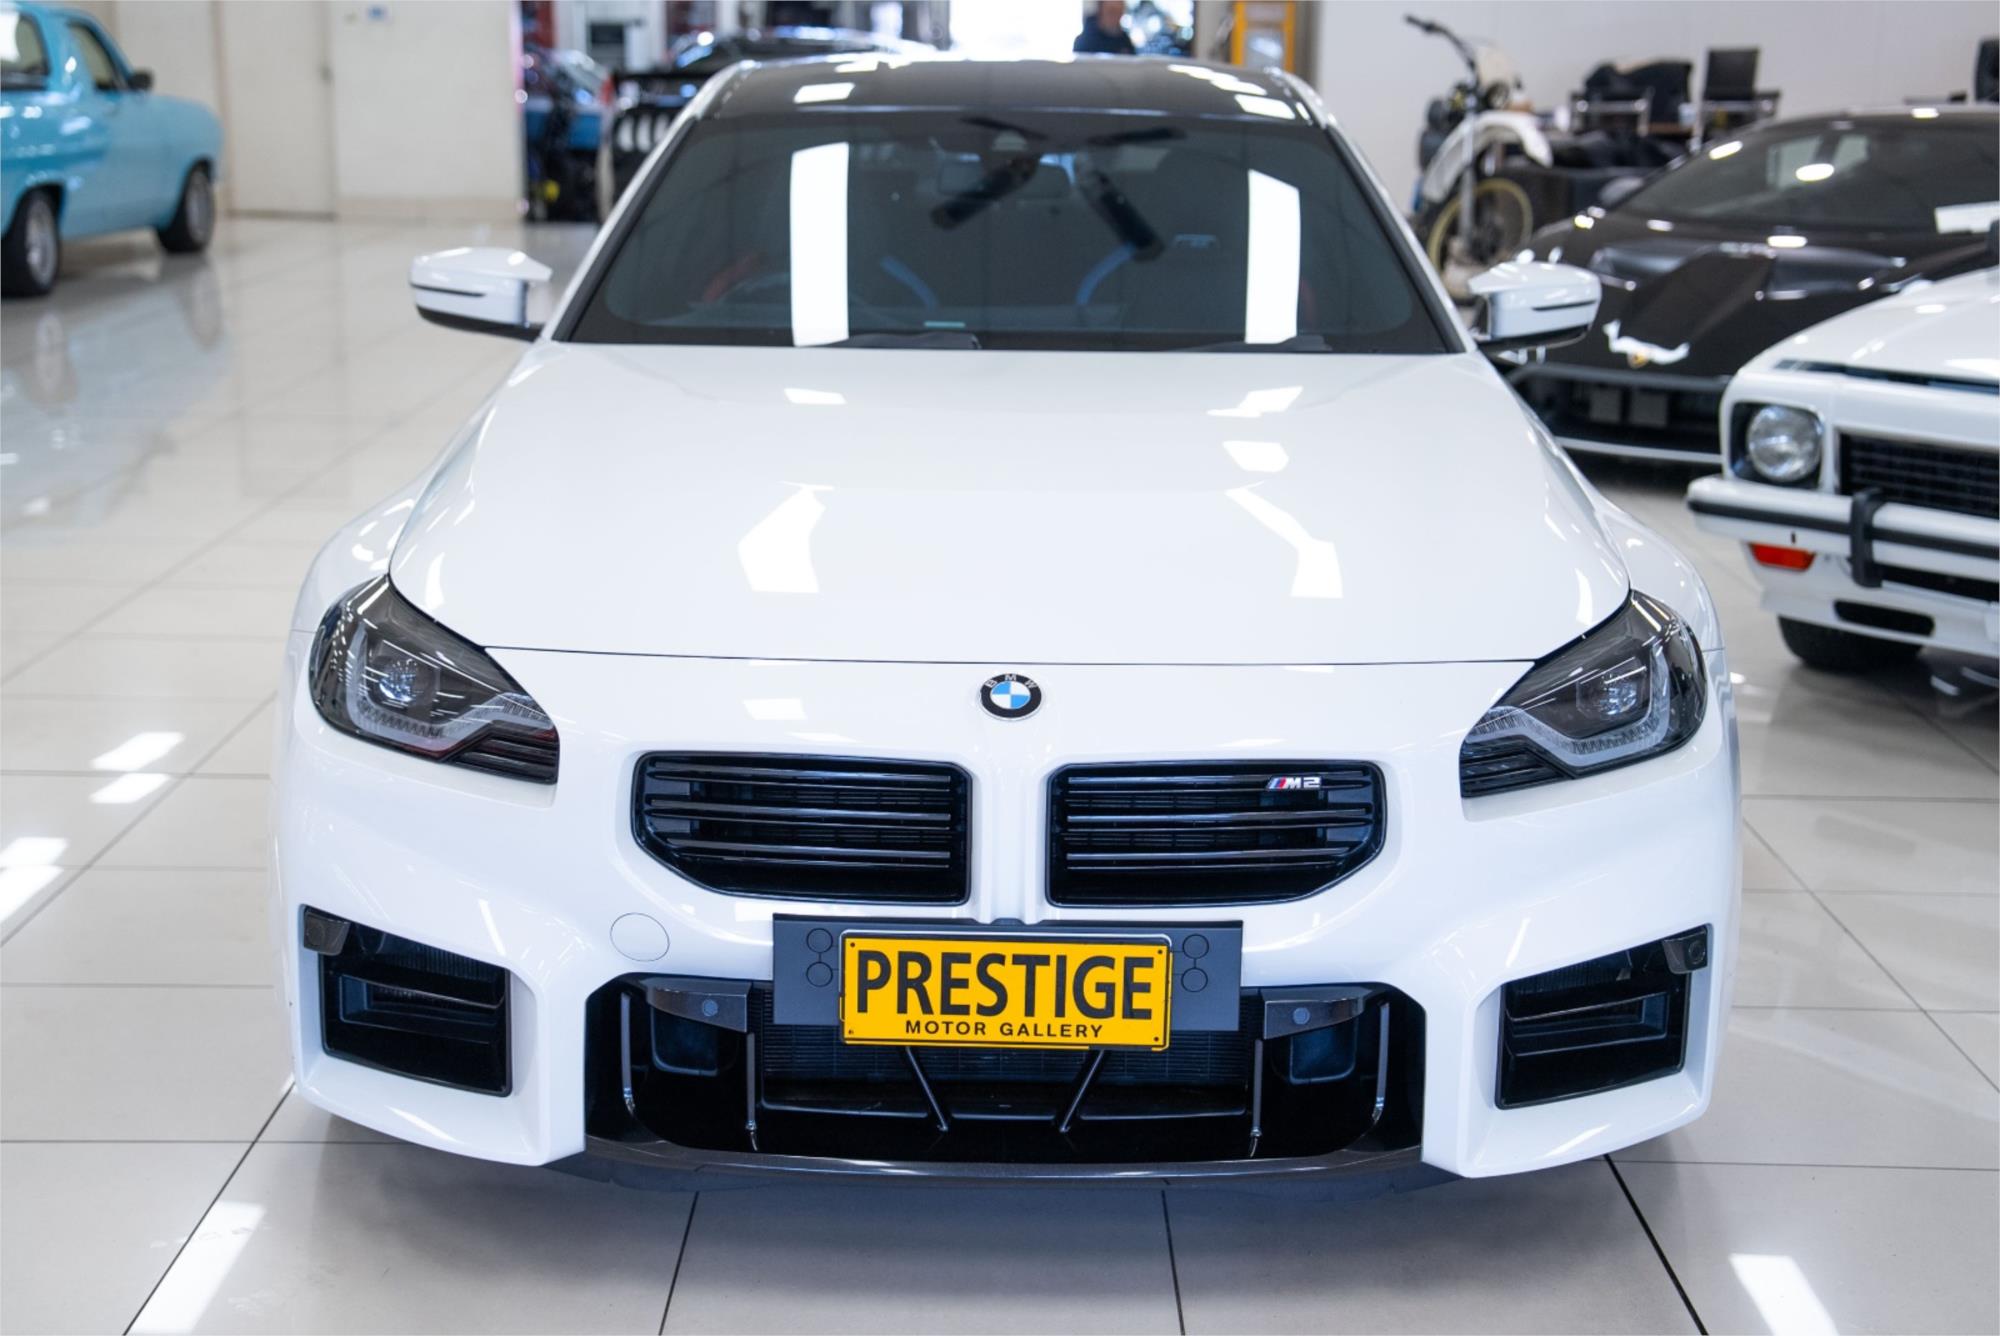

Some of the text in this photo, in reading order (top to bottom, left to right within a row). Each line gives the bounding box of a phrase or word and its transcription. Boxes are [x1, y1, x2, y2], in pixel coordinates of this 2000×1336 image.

[857, 950, 1154, 1020] PRESTIGE
[905, 1020, 1103, 1038] MOTOR GALLERY
